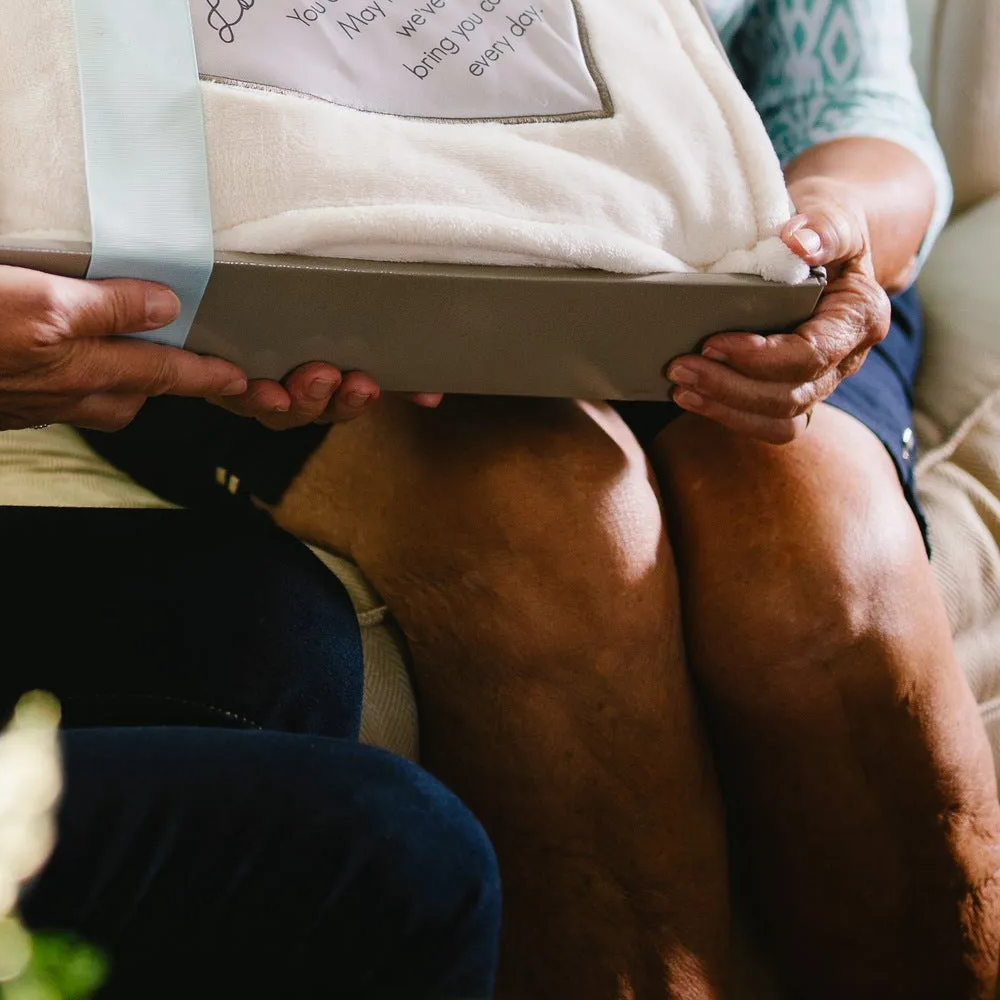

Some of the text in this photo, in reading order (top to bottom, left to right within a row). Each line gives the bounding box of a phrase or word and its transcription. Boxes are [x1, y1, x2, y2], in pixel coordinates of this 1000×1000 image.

[286, 1, 326, 27] You
[336, 0, 387, 40] May
[468, 4, 545, 77] every day.
[402, 36, 460, 80] bring
[452, 12, 483, 42] you
